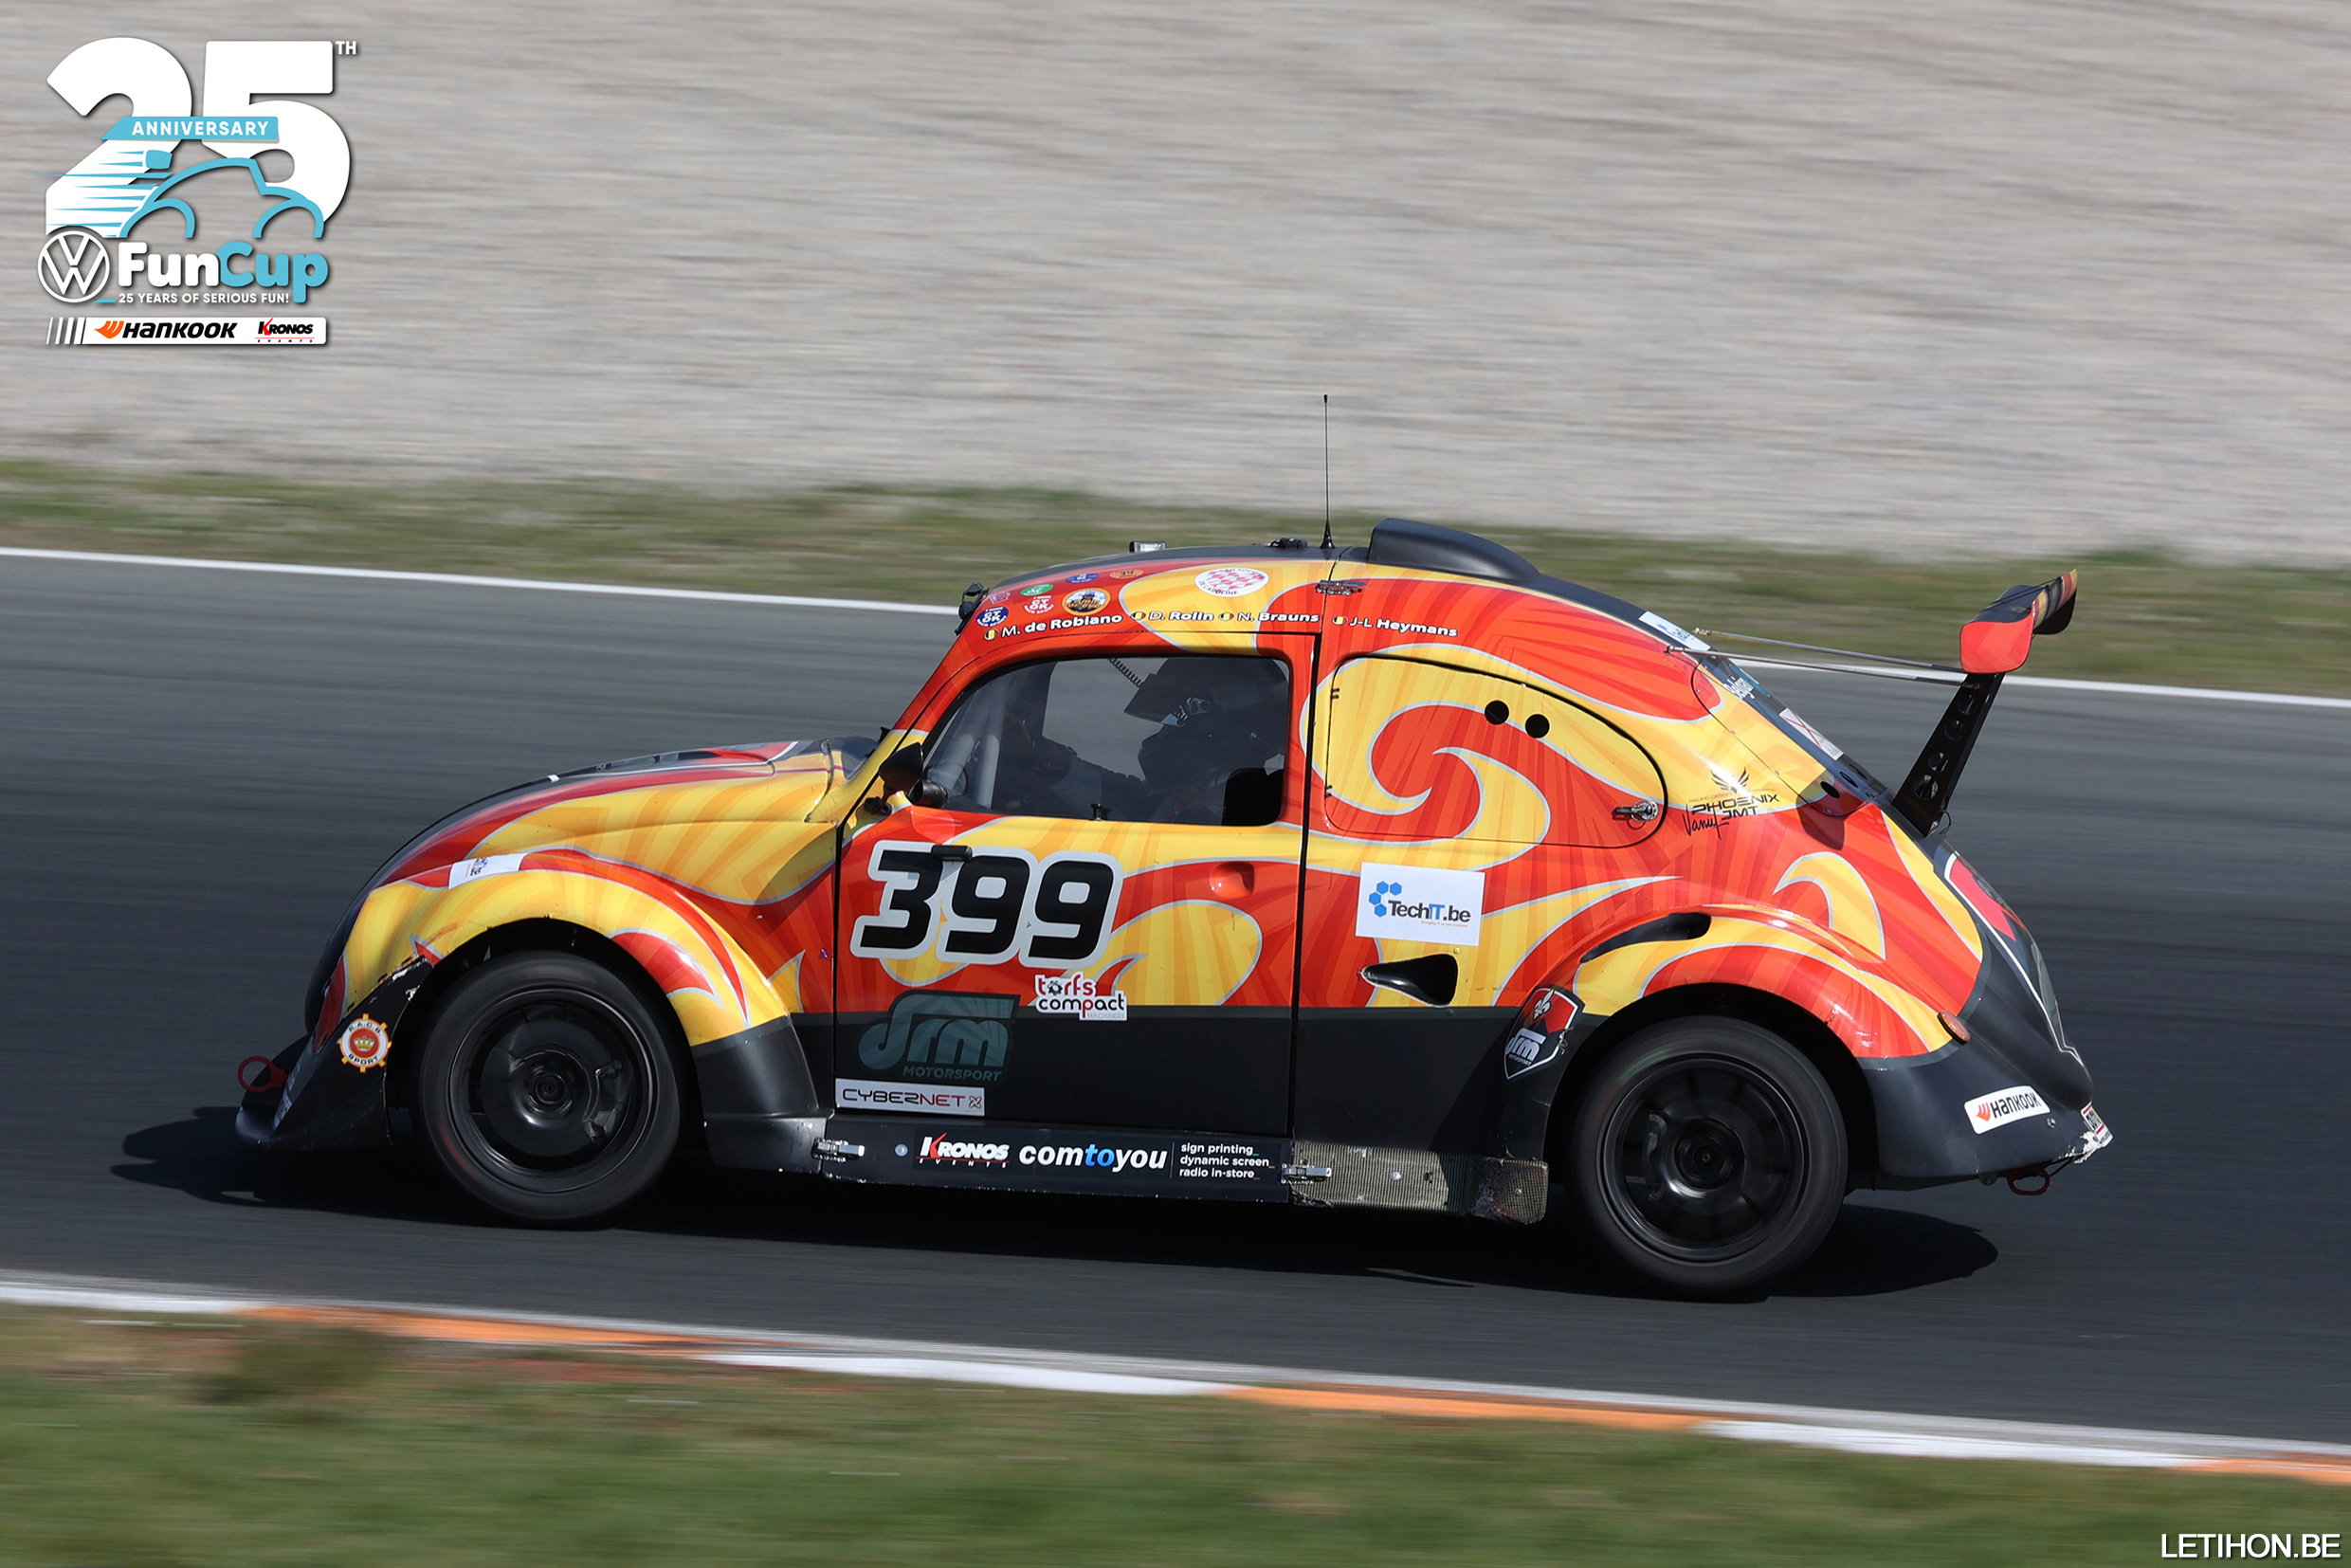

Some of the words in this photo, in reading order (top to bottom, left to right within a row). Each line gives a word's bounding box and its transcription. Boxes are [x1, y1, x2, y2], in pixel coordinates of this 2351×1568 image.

[1001, 626, 1021, 638] M.
[1024, 621, 1046, 633] de
[1049, 614, 1123, 630] Robiano
[1149, 611, 1165, 621] D.
[1169, 611, 1214, 622] Rolin
[1237, 611, 1254, 622] N.
[1259, 612, 1320, 623] Brauns
[1349, 616, 1373, 628] J-L
[1376, 618, 1458, 637] Heymans
[1691, 793, 1780, 814] PHOENIX
[858, 848, 1115, 961] 399
[1388, 900, 1471, 922] TechIT.be
[1038, 994, 1124, 1018] compact
[349, 1053, 378, 1065] SPORT
[902, 1065, 1002, 1082] MOTORSPORT
[920, 1132, 1010, 1160] KRONOS
[1180, 1142, 1205, 1155] sign
[1019, 1143, 1167, 1173] comtoyou
[1179, 1155, 1230, 1166] dynamic
[1179, 1167, 1209, 1177] radio
